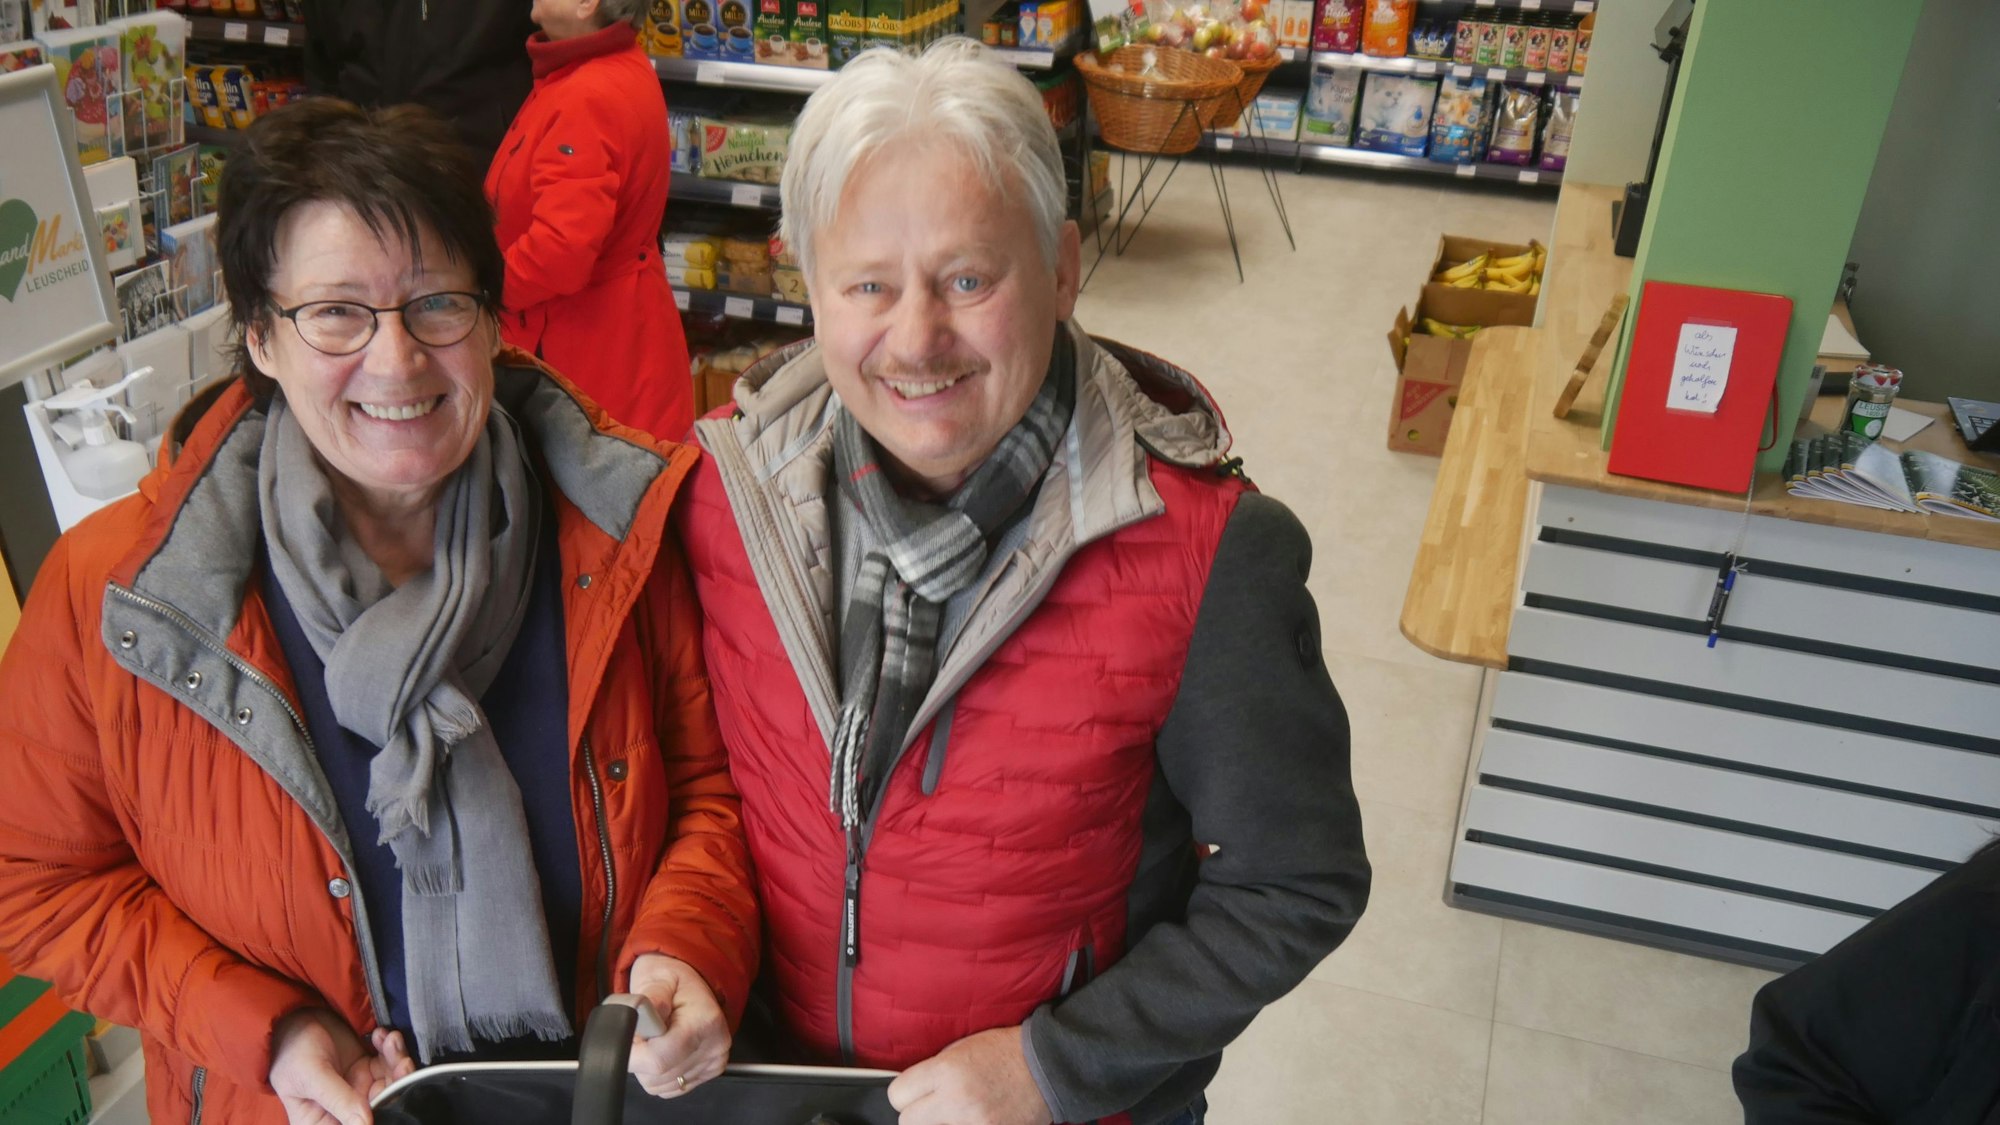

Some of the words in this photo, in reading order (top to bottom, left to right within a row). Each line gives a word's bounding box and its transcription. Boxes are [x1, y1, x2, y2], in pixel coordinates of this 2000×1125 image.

[757, 13, 785, 25] Auslese
[793, 17, 822, 28] Auslese
[829, 16, 862, 28] JACOBS
[867, 20, 900, 32] JACOBS
[713, 147, 785, 173] Hörnchen
[0, 232, 31, 265] and
[25, 259, 90, 293] LEUSCHEID
[789, 279, 799, 293] 2
